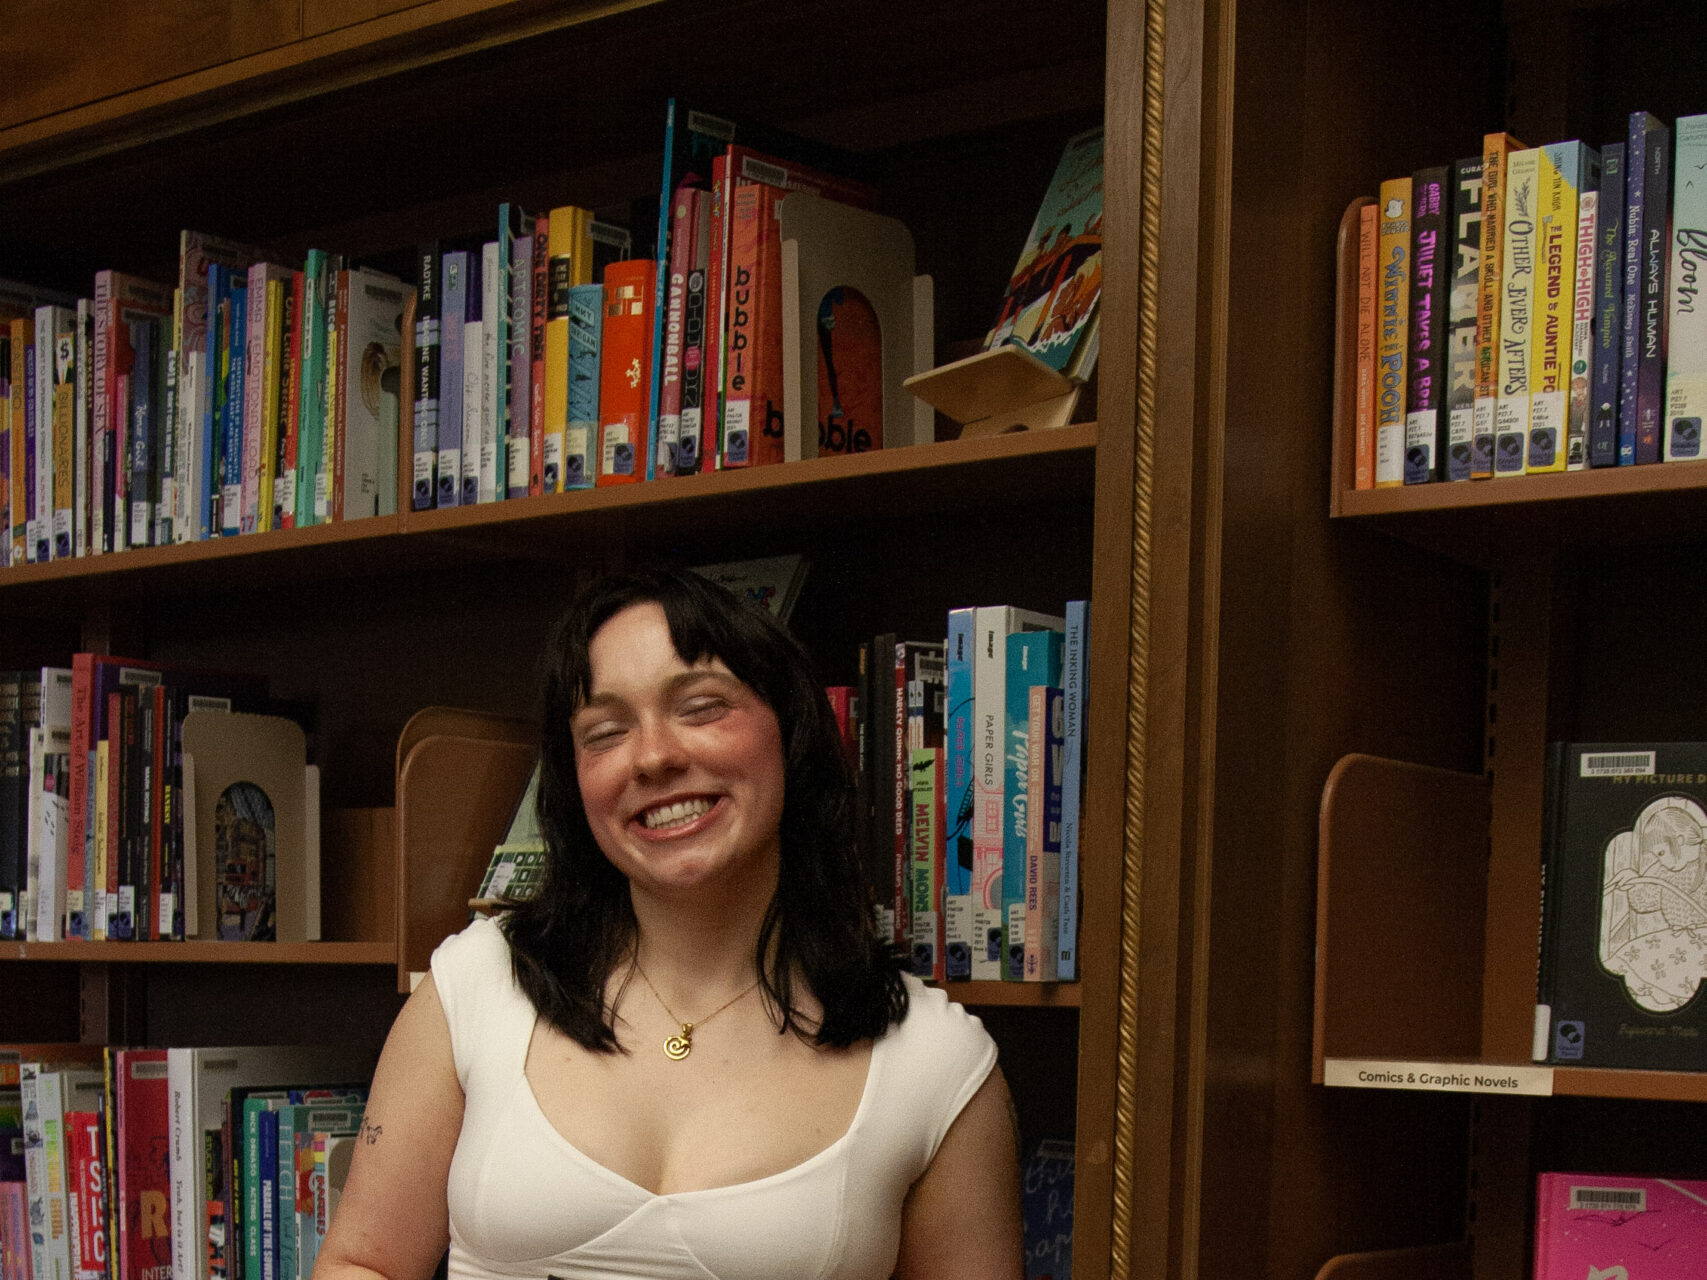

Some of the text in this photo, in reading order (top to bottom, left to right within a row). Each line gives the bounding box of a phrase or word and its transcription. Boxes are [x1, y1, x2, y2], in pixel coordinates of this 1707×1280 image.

[1551, 152, 1563, 212] SHING YIN KHOR
[1653, 146, 1662, 175] NORTH
[536, 233, 548, 268] ONE
[1578, 213, 1595, 269] THIGH
[1605, 217, 1619, 246] The
[1627, 240, 1639, 263] Real
[1358, 231, 1372, 360] WILL NOT DIE ALONE
[1452, 177, 1483, 392] FLAMER
[1480, 151, 1499, 386] THE GIRL WHO MARRIED SKULL AND OTHER AFRICAN
[1547, 234, 1563, 299] LEGEND
[1626, 265, 1638, 286] One
[1645, 229, 1661, 358] ALWAYS HUMAN
[513, 258, 526, 356] ART COMIC
[1415, 229, 1437, 372] JULIET TAKES A
[1504, 220, 1535, 396] OTHER EVER AFTERS
[1575, 277, 1592, 322] HIGH
[60, 341, 69, 360] $
[419, 255, 431, 449] RADTKE IMAGINE WANTING ONLY
[664, 272, 684, 386] CANNONBALL
[730, 266, 752, 392] bubble
[1543, 314, 1559, 371] AUNTIE
[12, 337, 21, 410] CASTRO
[94, 284, 107, 434] THE STORY OF SEX
[248, 277, 263, 481] EMMA EMOTIONAL LOAD
[280, 379, 291, 426] SECRET
[1379, 352, 1403, 425] POOH
[58, 392, 69, 486] BILLIONAIRES
[135, 440, 145, 467] Girl
[895, 687, 903, 726] HARLEY
[1066, 625, 1080, 737] THE INKING WOMAN
[71, 687, 86, 855] The Art of William Steig
[895, 764, 902, 778] NO
[955, 716, 964, 787] PAPER GIRLS
[984, 714, 995, 786] PAPER GIRLS
[1635, 773, 1694, 784] PICTURE
[915, 803, 930, 912] MELVIN MONS
[1064, 822, 1073, 848] Nicola
[1028, 855, 1038, 911] DAVID REES
[174, 1090, 183, 1125] Robert
[1358, 1070, 1519, 1089] Comics & Graphic Novels
[174, 1127, 183, 1161] Crumb
[278, 1124, 292, 1201] FETCH
[249, 1111, 257, 1257] NICK DRNASO ACTING CLASS
[262, 1179, 273, 1219] PARABLE
[175, 1210, 184, 1228] but
[262, 1220, 273, 1231] OF
[262, 1232, 273, 1250] THE
[176, 1250, 184, 1274] Art?
